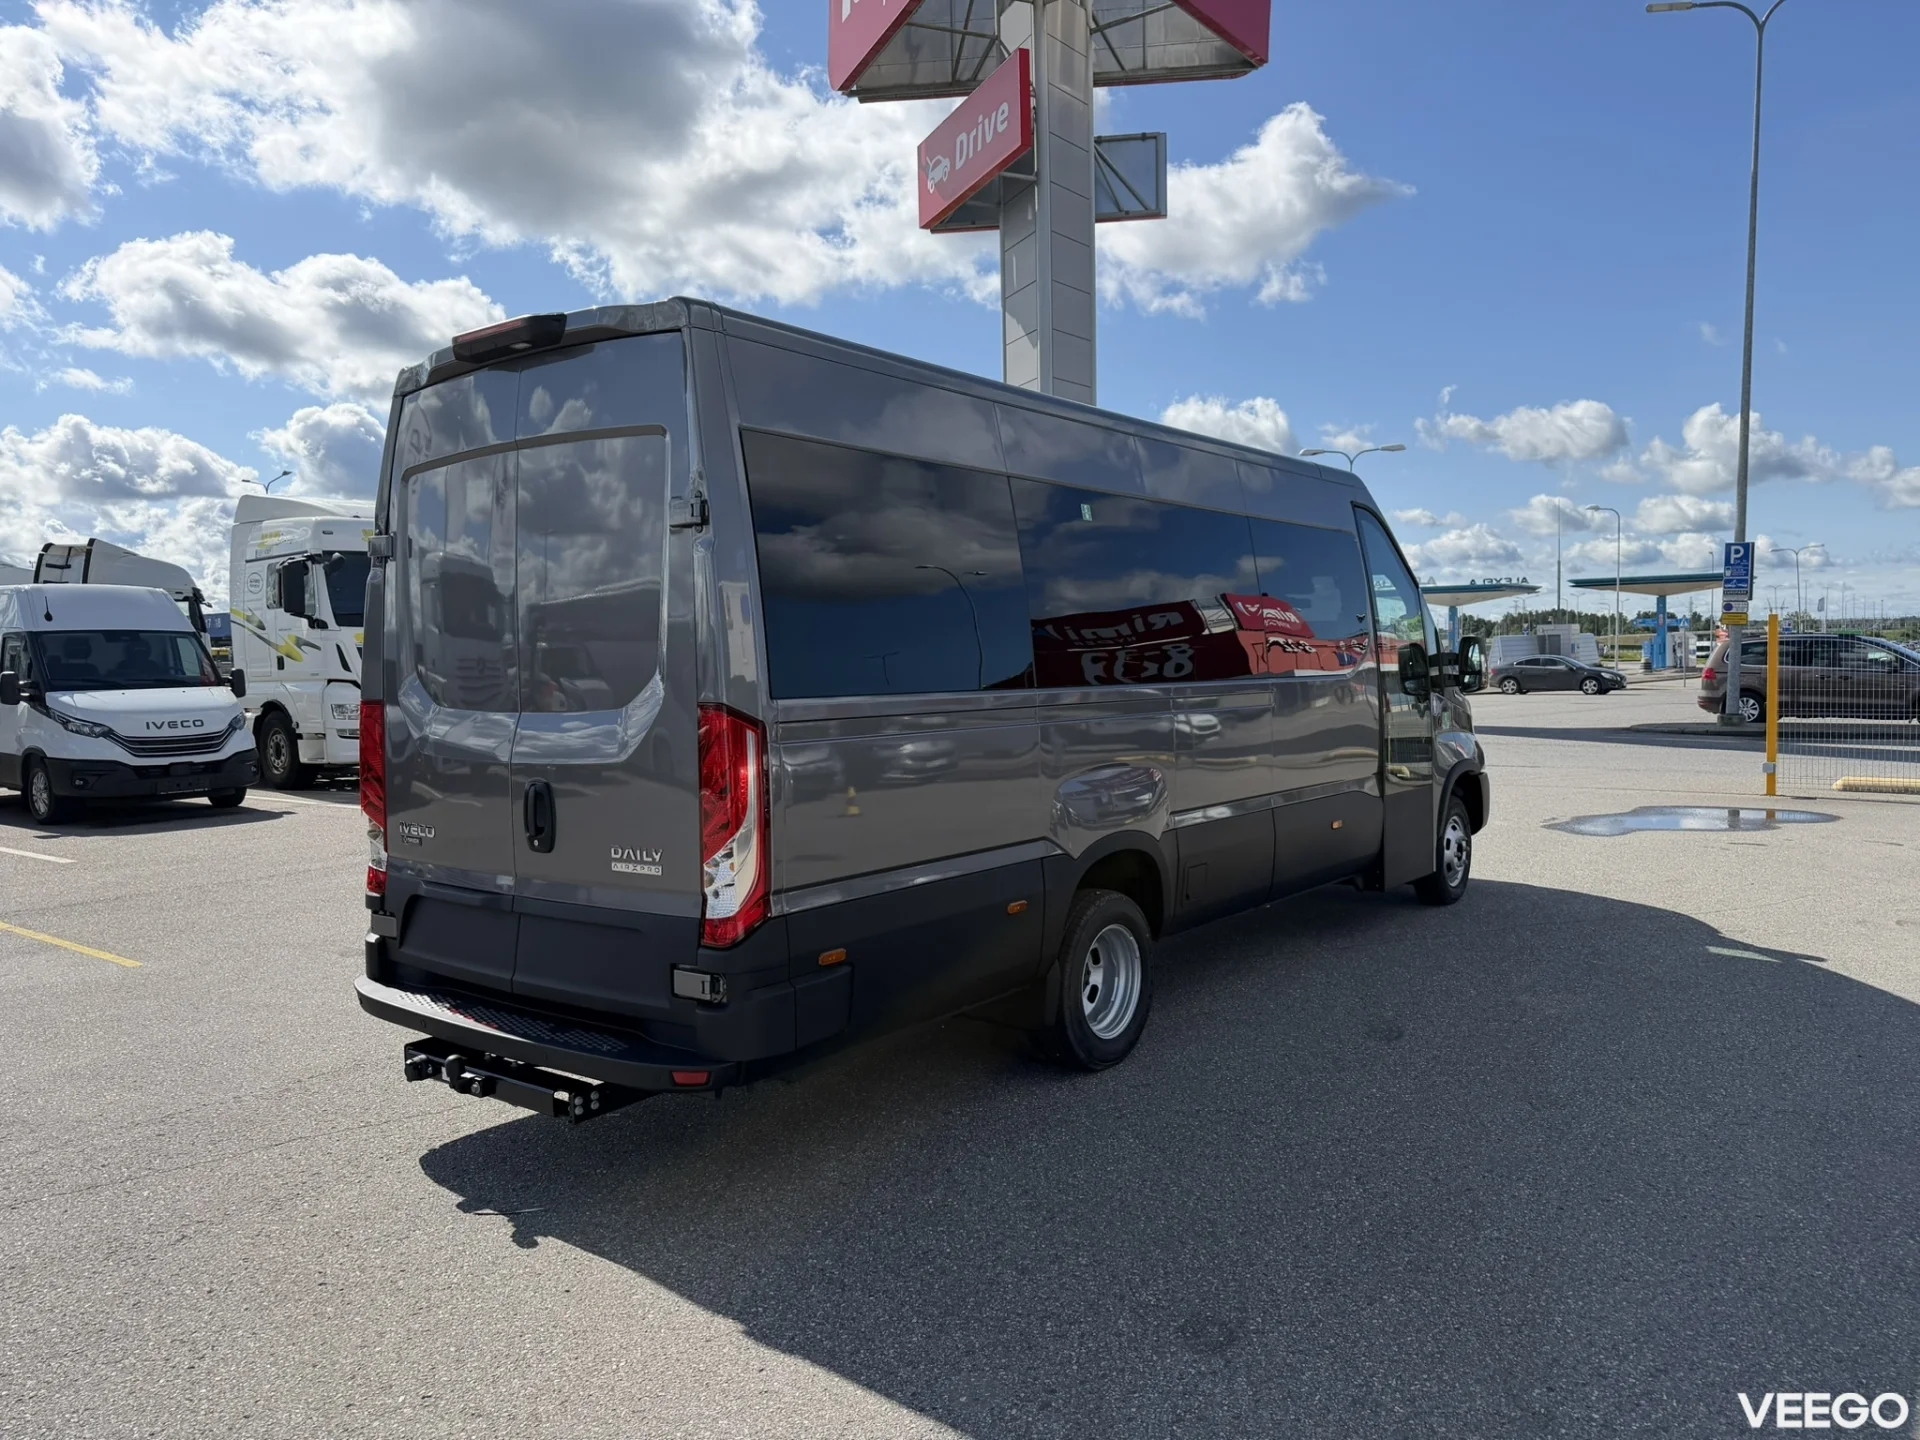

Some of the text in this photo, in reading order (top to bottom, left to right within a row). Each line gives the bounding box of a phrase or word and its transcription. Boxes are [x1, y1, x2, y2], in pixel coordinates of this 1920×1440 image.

[955, 101, 1009, 171] Drive
[1730, 545, 1745, 564] P
[145, 718, 205, 732] IVECO
[399, 821, 436, 839] IVECO
[610, 845, 663, 863] DAILY
